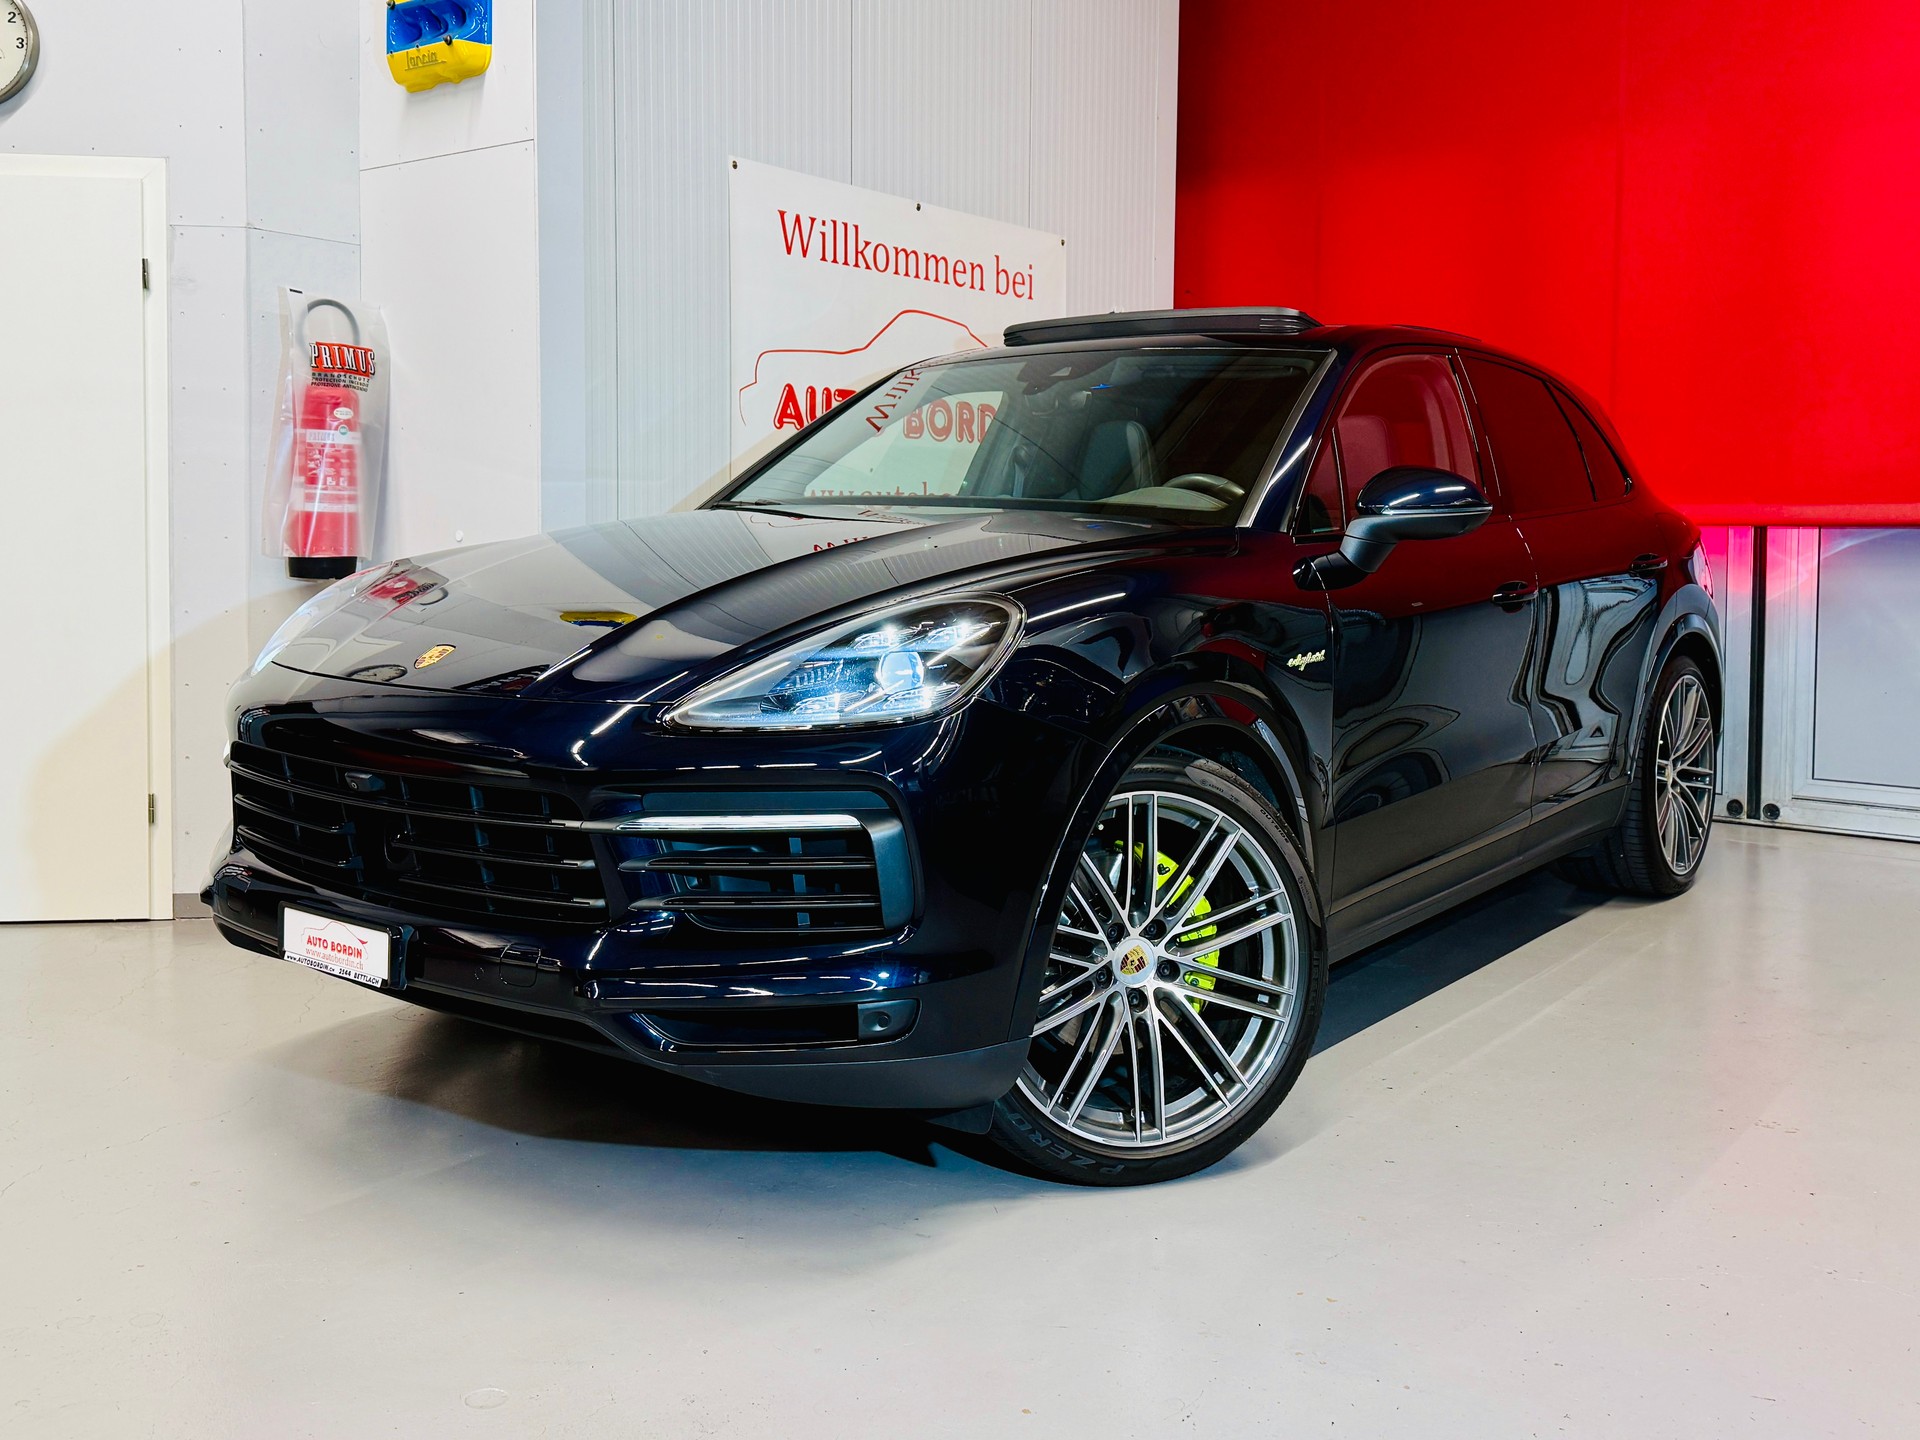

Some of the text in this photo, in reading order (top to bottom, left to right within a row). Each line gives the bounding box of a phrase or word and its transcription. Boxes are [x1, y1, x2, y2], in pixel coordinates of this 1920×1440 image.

[7, 11, 17, 24] 2
[16, 37, 25, 49] 3
[777, 209, 1034, 300] Willkommen bei
[309, 342, 376, 376] PRIMUS
[312, 372, 370, 383] BRANDSCHUTZ
[903, 398, 998, 445] BORD
[306, 935, 362, 959] AUTO BORDIN
[305, 948, 364, 971] www.autobordin.ch
